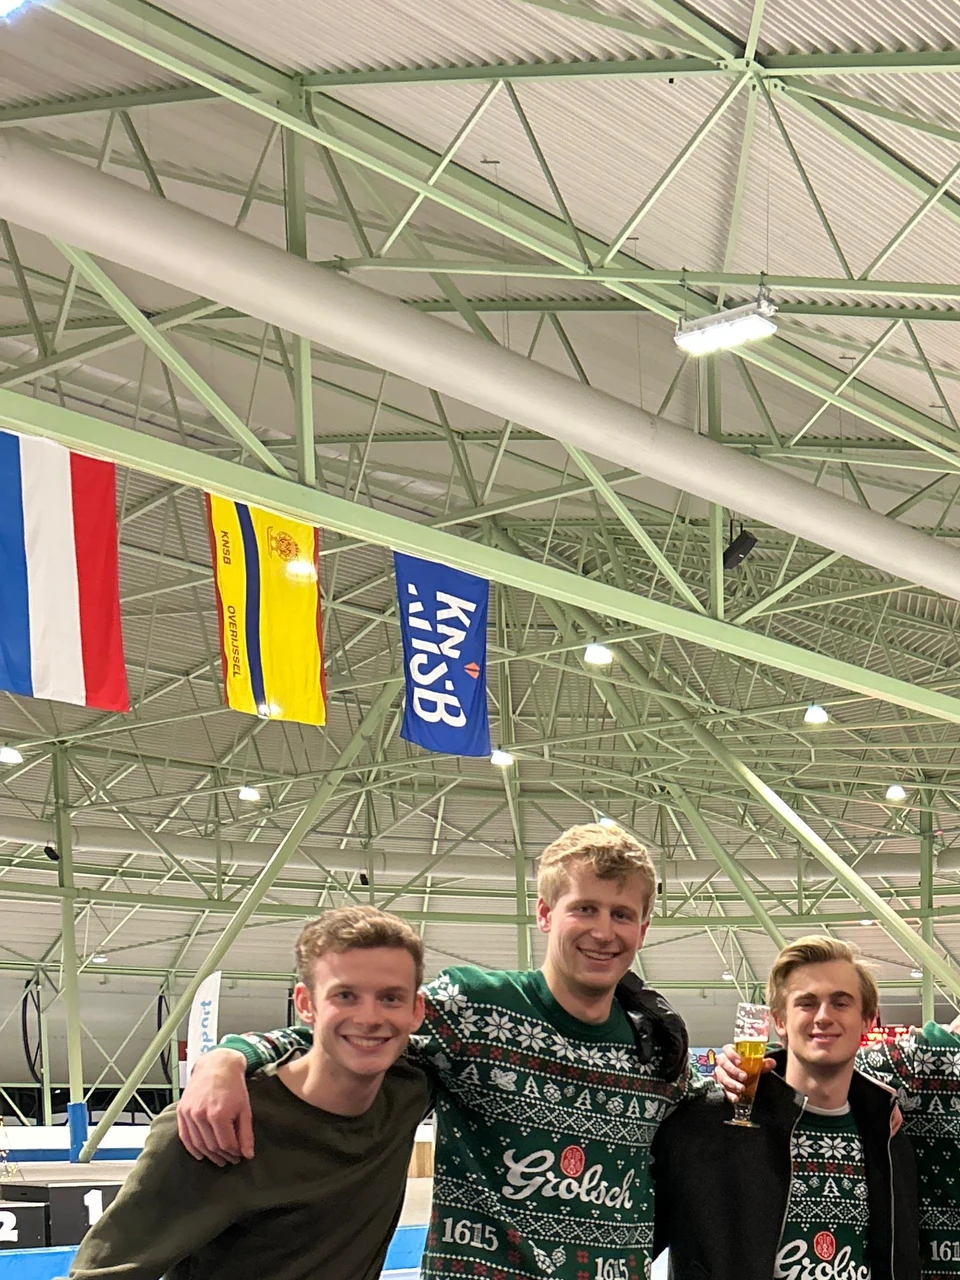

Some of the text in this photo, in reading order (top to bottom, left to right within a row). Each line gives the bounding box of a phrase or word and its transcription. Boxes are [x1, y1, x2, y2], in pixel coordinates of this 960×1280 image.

[221, 530, 231, 565] KNSB
[227, 605, 241, 677] OVERIJSSEL
[407, 583, 477, 727] KNSB
[502, 1148, 635, 1209] Grolsch
[0, 1210, 18, 1242] 2
[84, 1189, 104, 1226] 1
[442, 1217, 499, 1252] 1615
